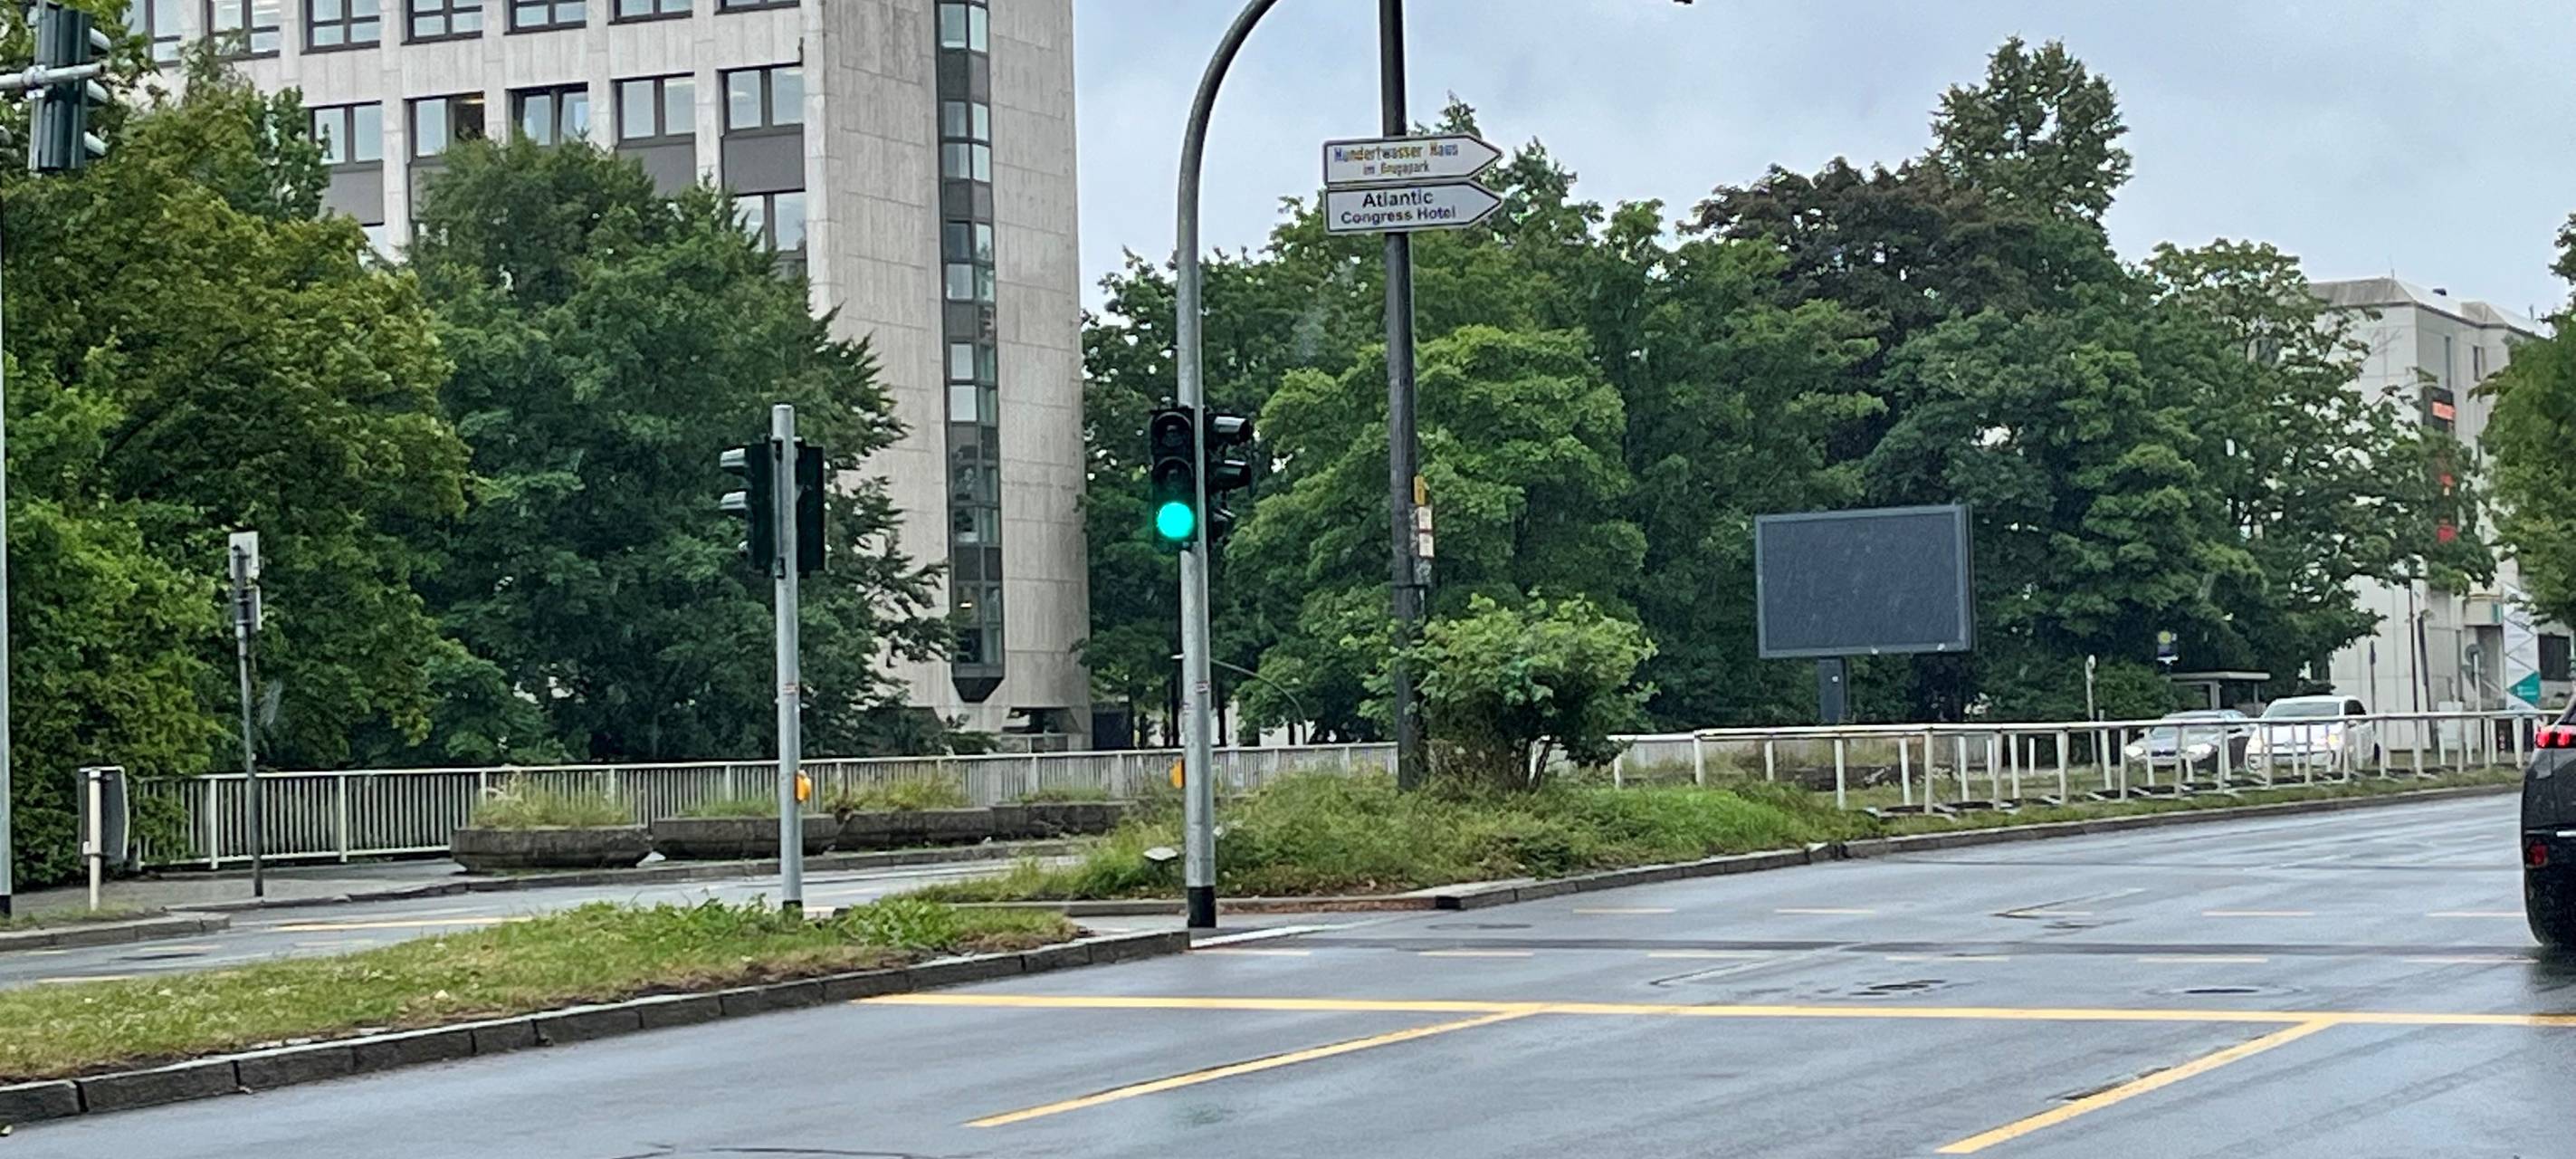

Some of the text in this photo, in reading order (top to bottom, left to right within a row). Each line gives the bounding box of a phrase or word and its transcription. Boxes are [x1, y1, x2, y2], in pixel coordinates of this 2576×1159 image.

[1334, 141, 1458, 162] Hundertwasser Haus
[1363, 164, 1375, 175] im
[1362, 188, 1434, 208] Atlantic
[1340, 205, 1456, 225] Congress Hotel
